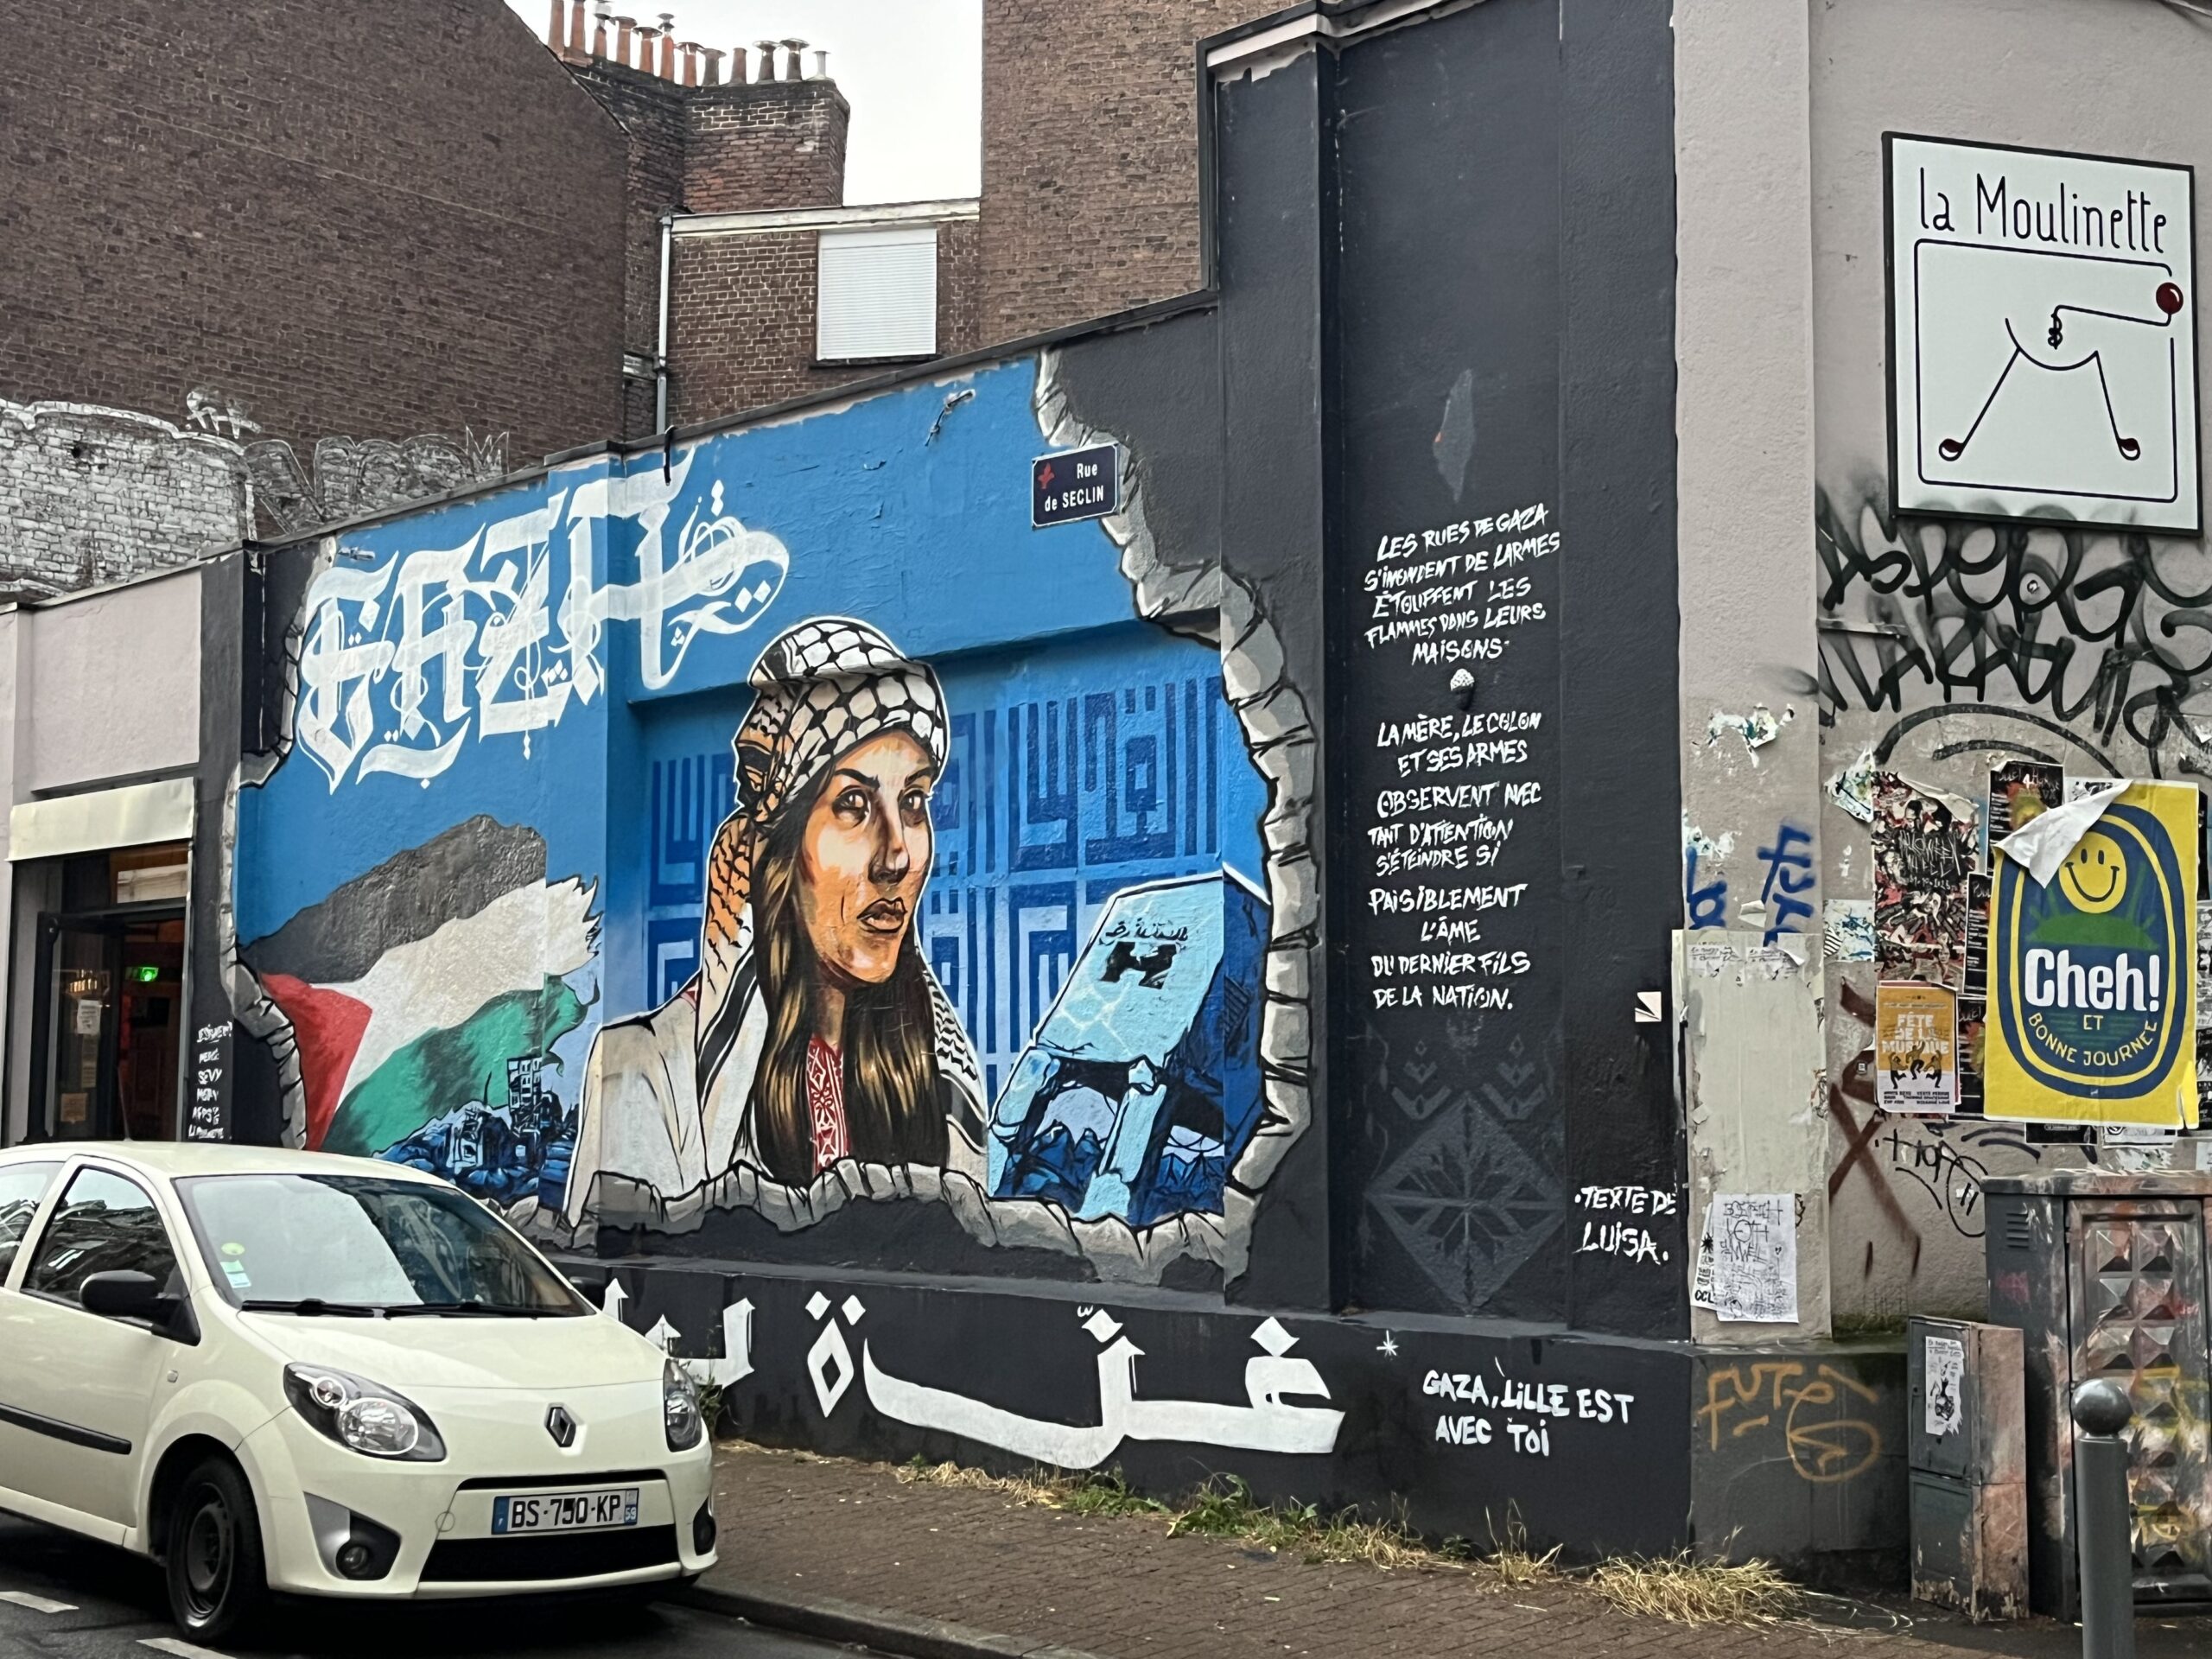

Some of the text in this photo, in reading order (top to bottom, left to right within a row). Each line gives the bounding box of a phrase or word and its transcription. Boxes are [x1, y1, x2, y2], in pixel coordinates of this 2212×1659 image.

[1920, 167, 2167, 252] la Moulinette
[1077, 463, 1097, 480] Rue
[1044, 485, 1104, 512] de SECLIN
[1377, 502, 1549, 562] LES RUES DE GAZA
[1465, 551, 1489, 573] DE
[1493, 532, 1560, 569] LARMES
[1487, 576, 1532, 602] LES
[1363, 602, 1546, 649] FLAMMES DANS LEURS
[1377, 722, 1400, 747] LA
[1462, 714, 1486, 738] LE
[1486, 711, 1541, 734] COLON
[1397, 740, 1528, 778] ET SES ARMES
[1376, 780, 1501, 818] OBSERVENT
[1367, 823, 1405, 849] TANT
[1370, 954, 1395, 978] DU
[2024, 948, 2160, 1012] Cheh!
[1372, 988, 1399, 1010] DE
[1402, 985, 1423, 1007] LA
[1897, 1010, 1935, 1027] FÊTE
[2082, 1014, 2104, 1031] ET
[2028, 1012, 2077, 1064] BONNE
[1650, 1189, 1677, 1216] DE
[1576, 1389, 1635, 1424] EST
[1435, 1415, 1492, 1446] AVEC
[624, 1506, 637, 1521] 59
